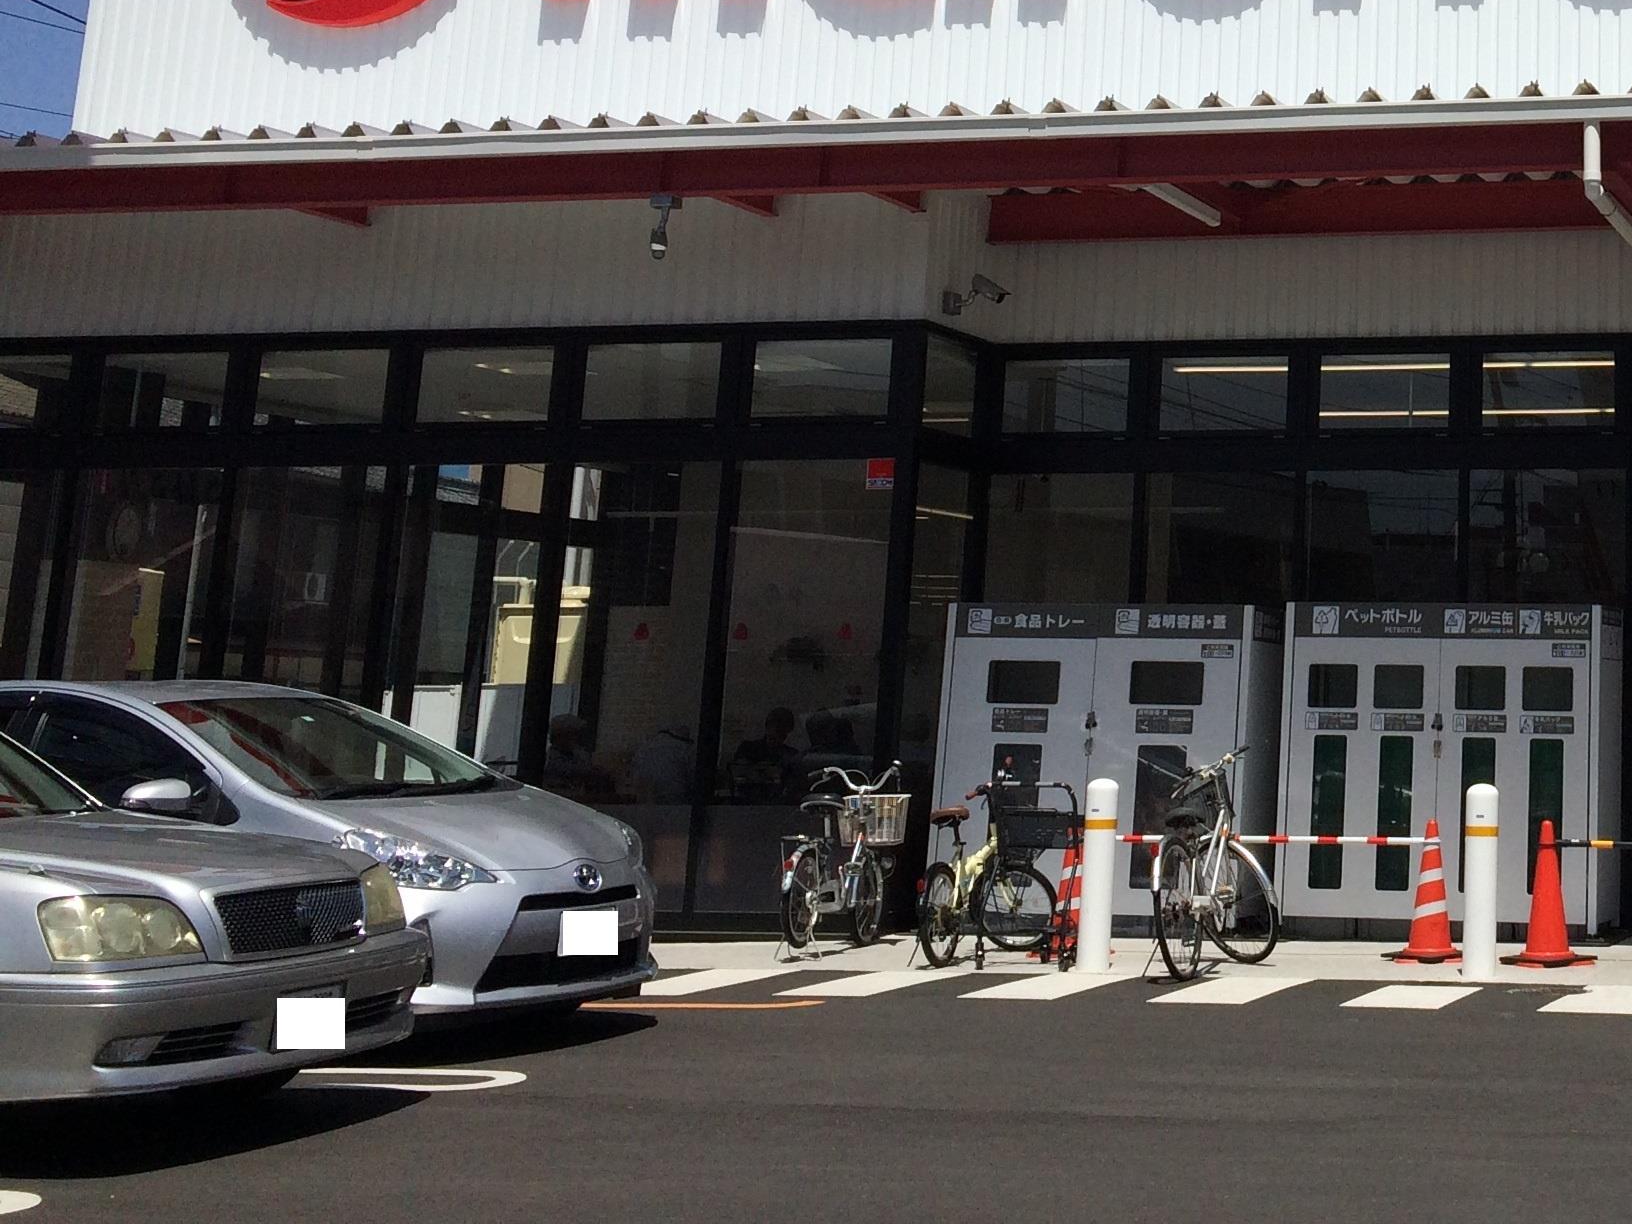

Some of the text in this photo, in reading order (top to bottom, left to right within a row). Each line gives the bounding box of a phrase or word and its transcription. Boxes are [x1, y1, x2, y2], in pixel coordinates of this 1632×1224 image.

[1013, 613, 1086, 629] 食品トレー
[1344, 608, 1422, 624] ペットボトル
[1467, 610, 1514, 626] アルミ缶
[1543, 610, 1590, 626] 牛乳パック
